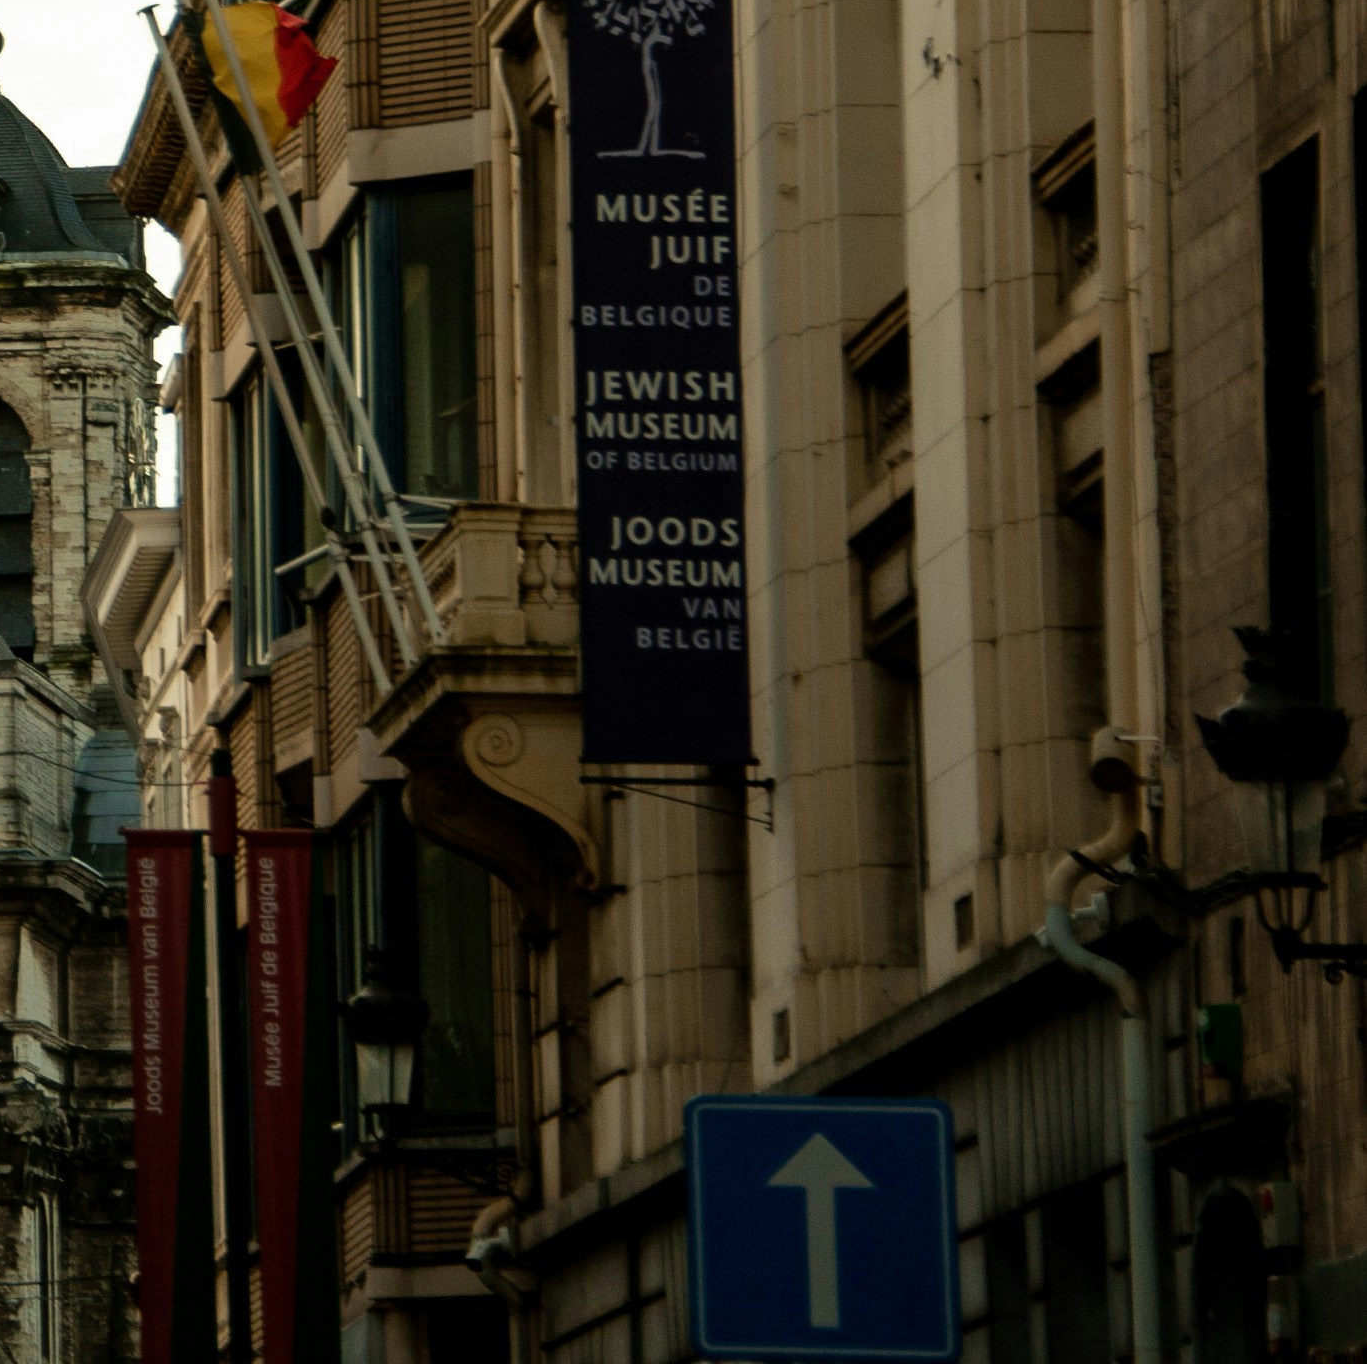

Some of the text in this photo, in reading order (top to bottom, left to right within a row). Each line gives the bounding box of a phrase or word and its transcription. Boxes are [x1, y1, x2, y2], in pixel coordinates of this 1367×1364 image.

[595, 187, 730, 224] MUSÉE
[648, 235, 731, 271] JUIF
[693, 275, 732, 297] DE
[580, 304, 733, 329] BELGIQUE
[583, 370, 736, 407] JEWISH
[584, 411, 739, 441] MUSEUM
[585, 450, 738, 472] OF BELGIUM
[609, 515, 740, 552] JOODS
[587, 556, 742, 587] MUSEUM
[682, 595, 742, 620] VAN
[635, 624, 742, 651] BELGIË
[141, 924, 159, 959] van
[258, 856, 283, 1087] Musée Juif de Belgique
[142, 964, 161, 1051] Museum
[143, 1054, 163, 1116] Joods
